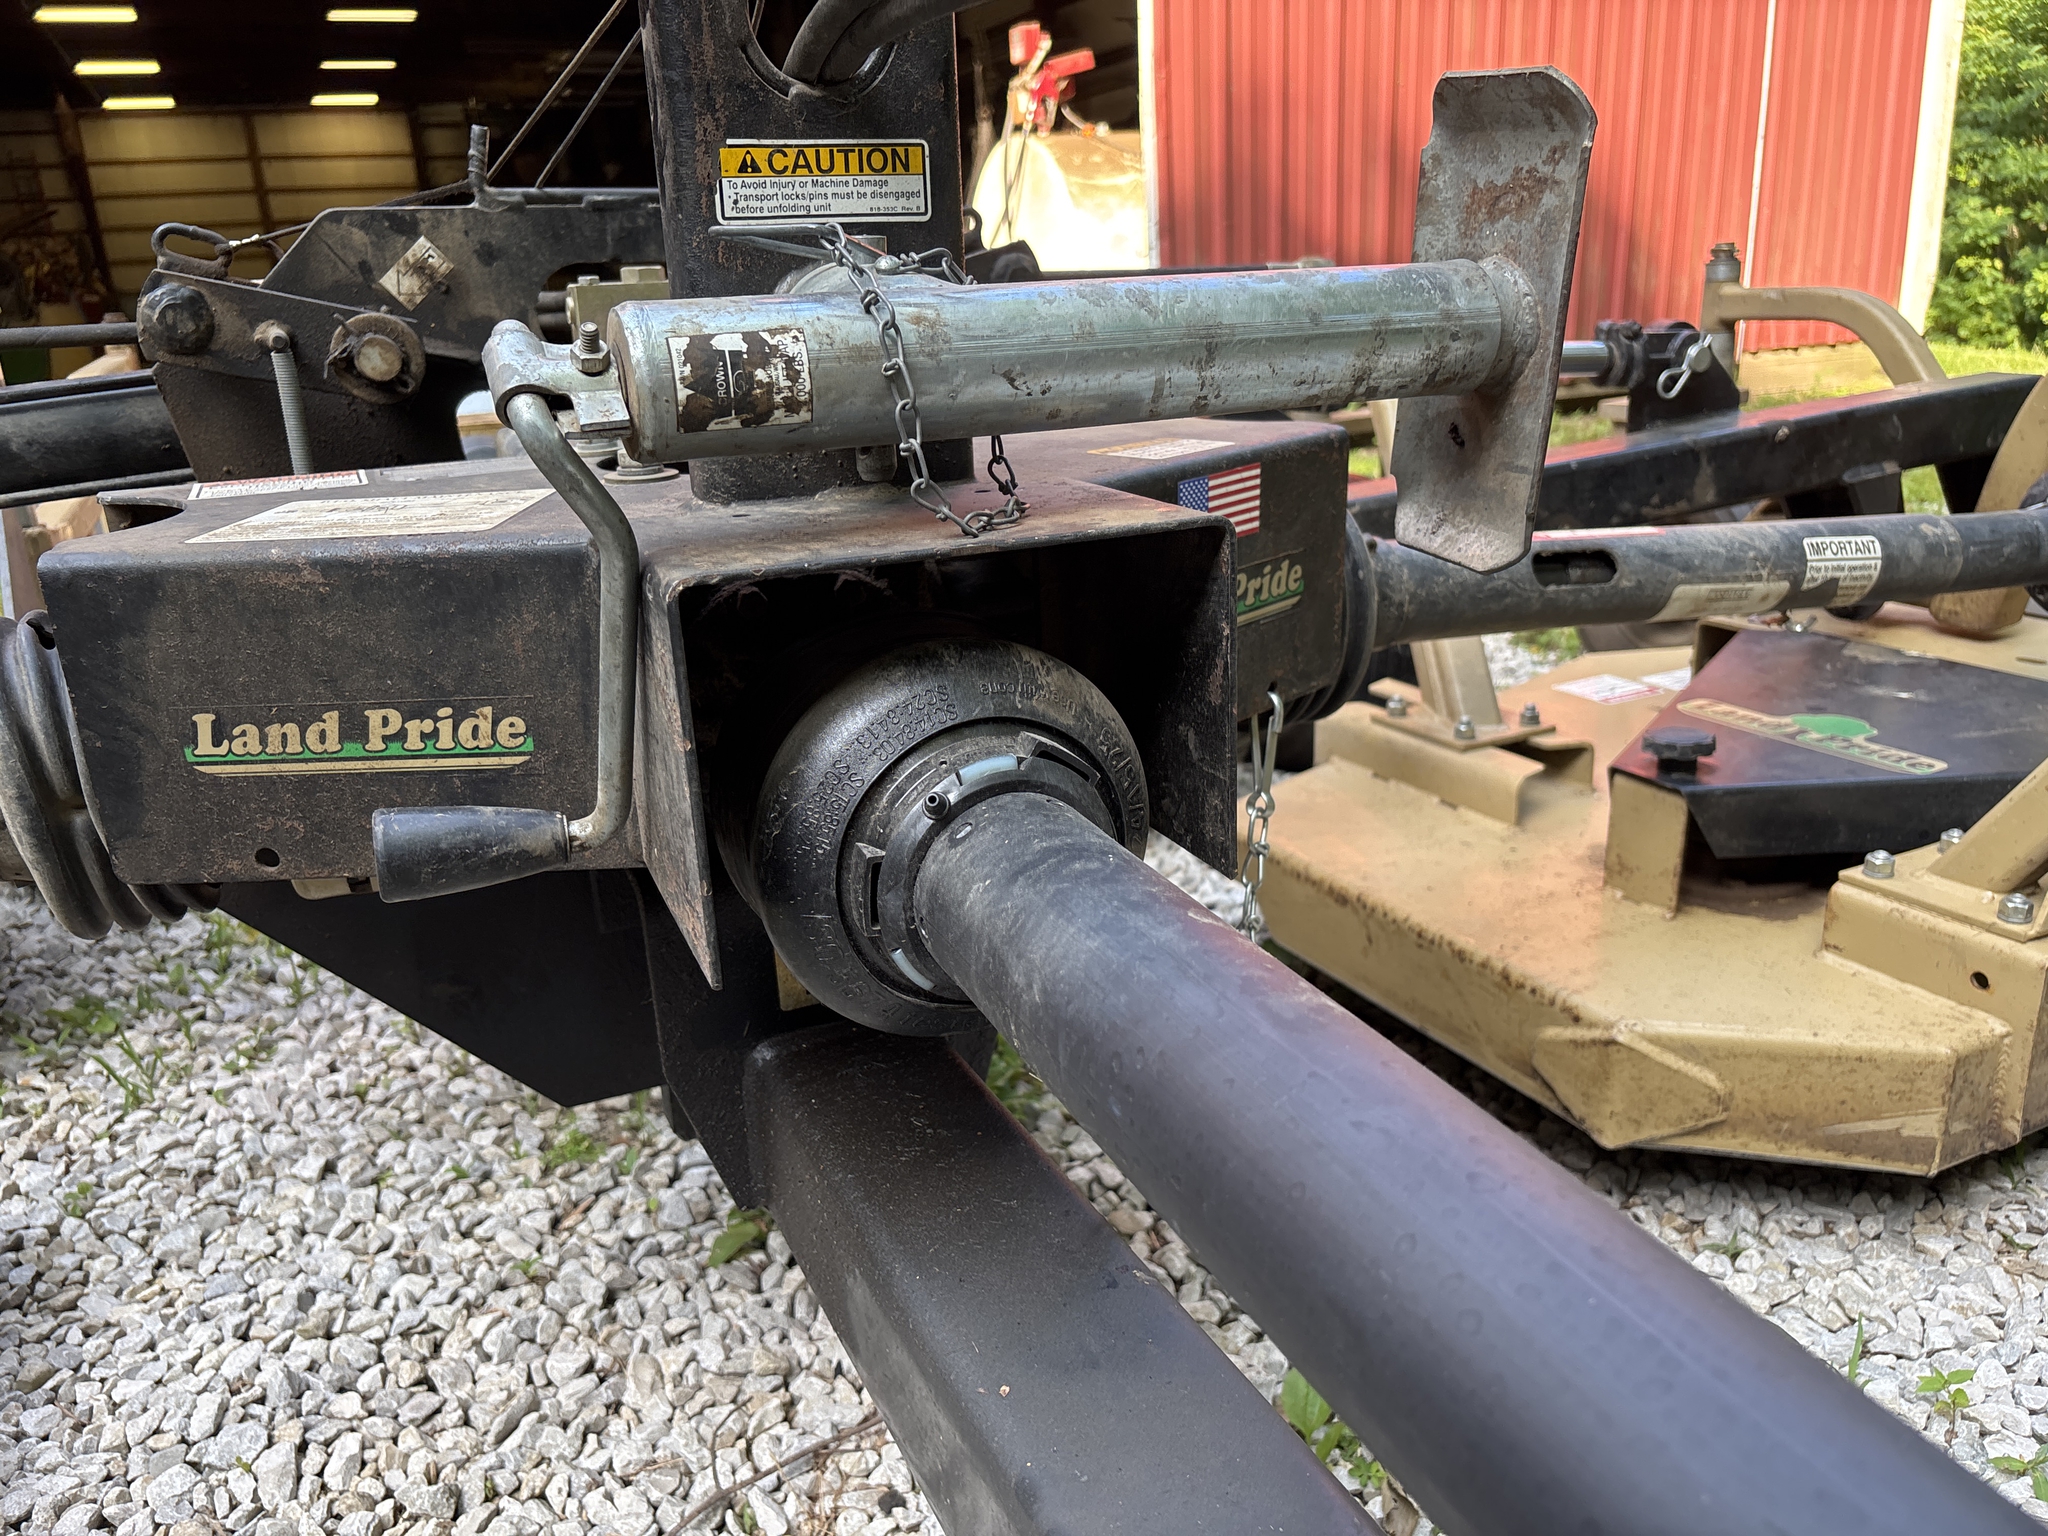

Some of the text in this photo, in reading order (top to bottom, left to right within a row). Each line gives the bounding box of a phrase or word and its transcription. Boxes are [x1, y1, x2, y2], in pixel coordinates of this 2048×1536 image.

[767, 148, 909, 174] CAUTION
[727, 177, 889, 191] To Avoid Injury or Machine Damage
[734, 189, 921, 204] Transport locks/pins must be disengaged
[735, 202, 832, 215] before unfolding unit
[1806, 540, 1877, 557] IMPORTANT
[191, 706, 527, 756] Land Pride
